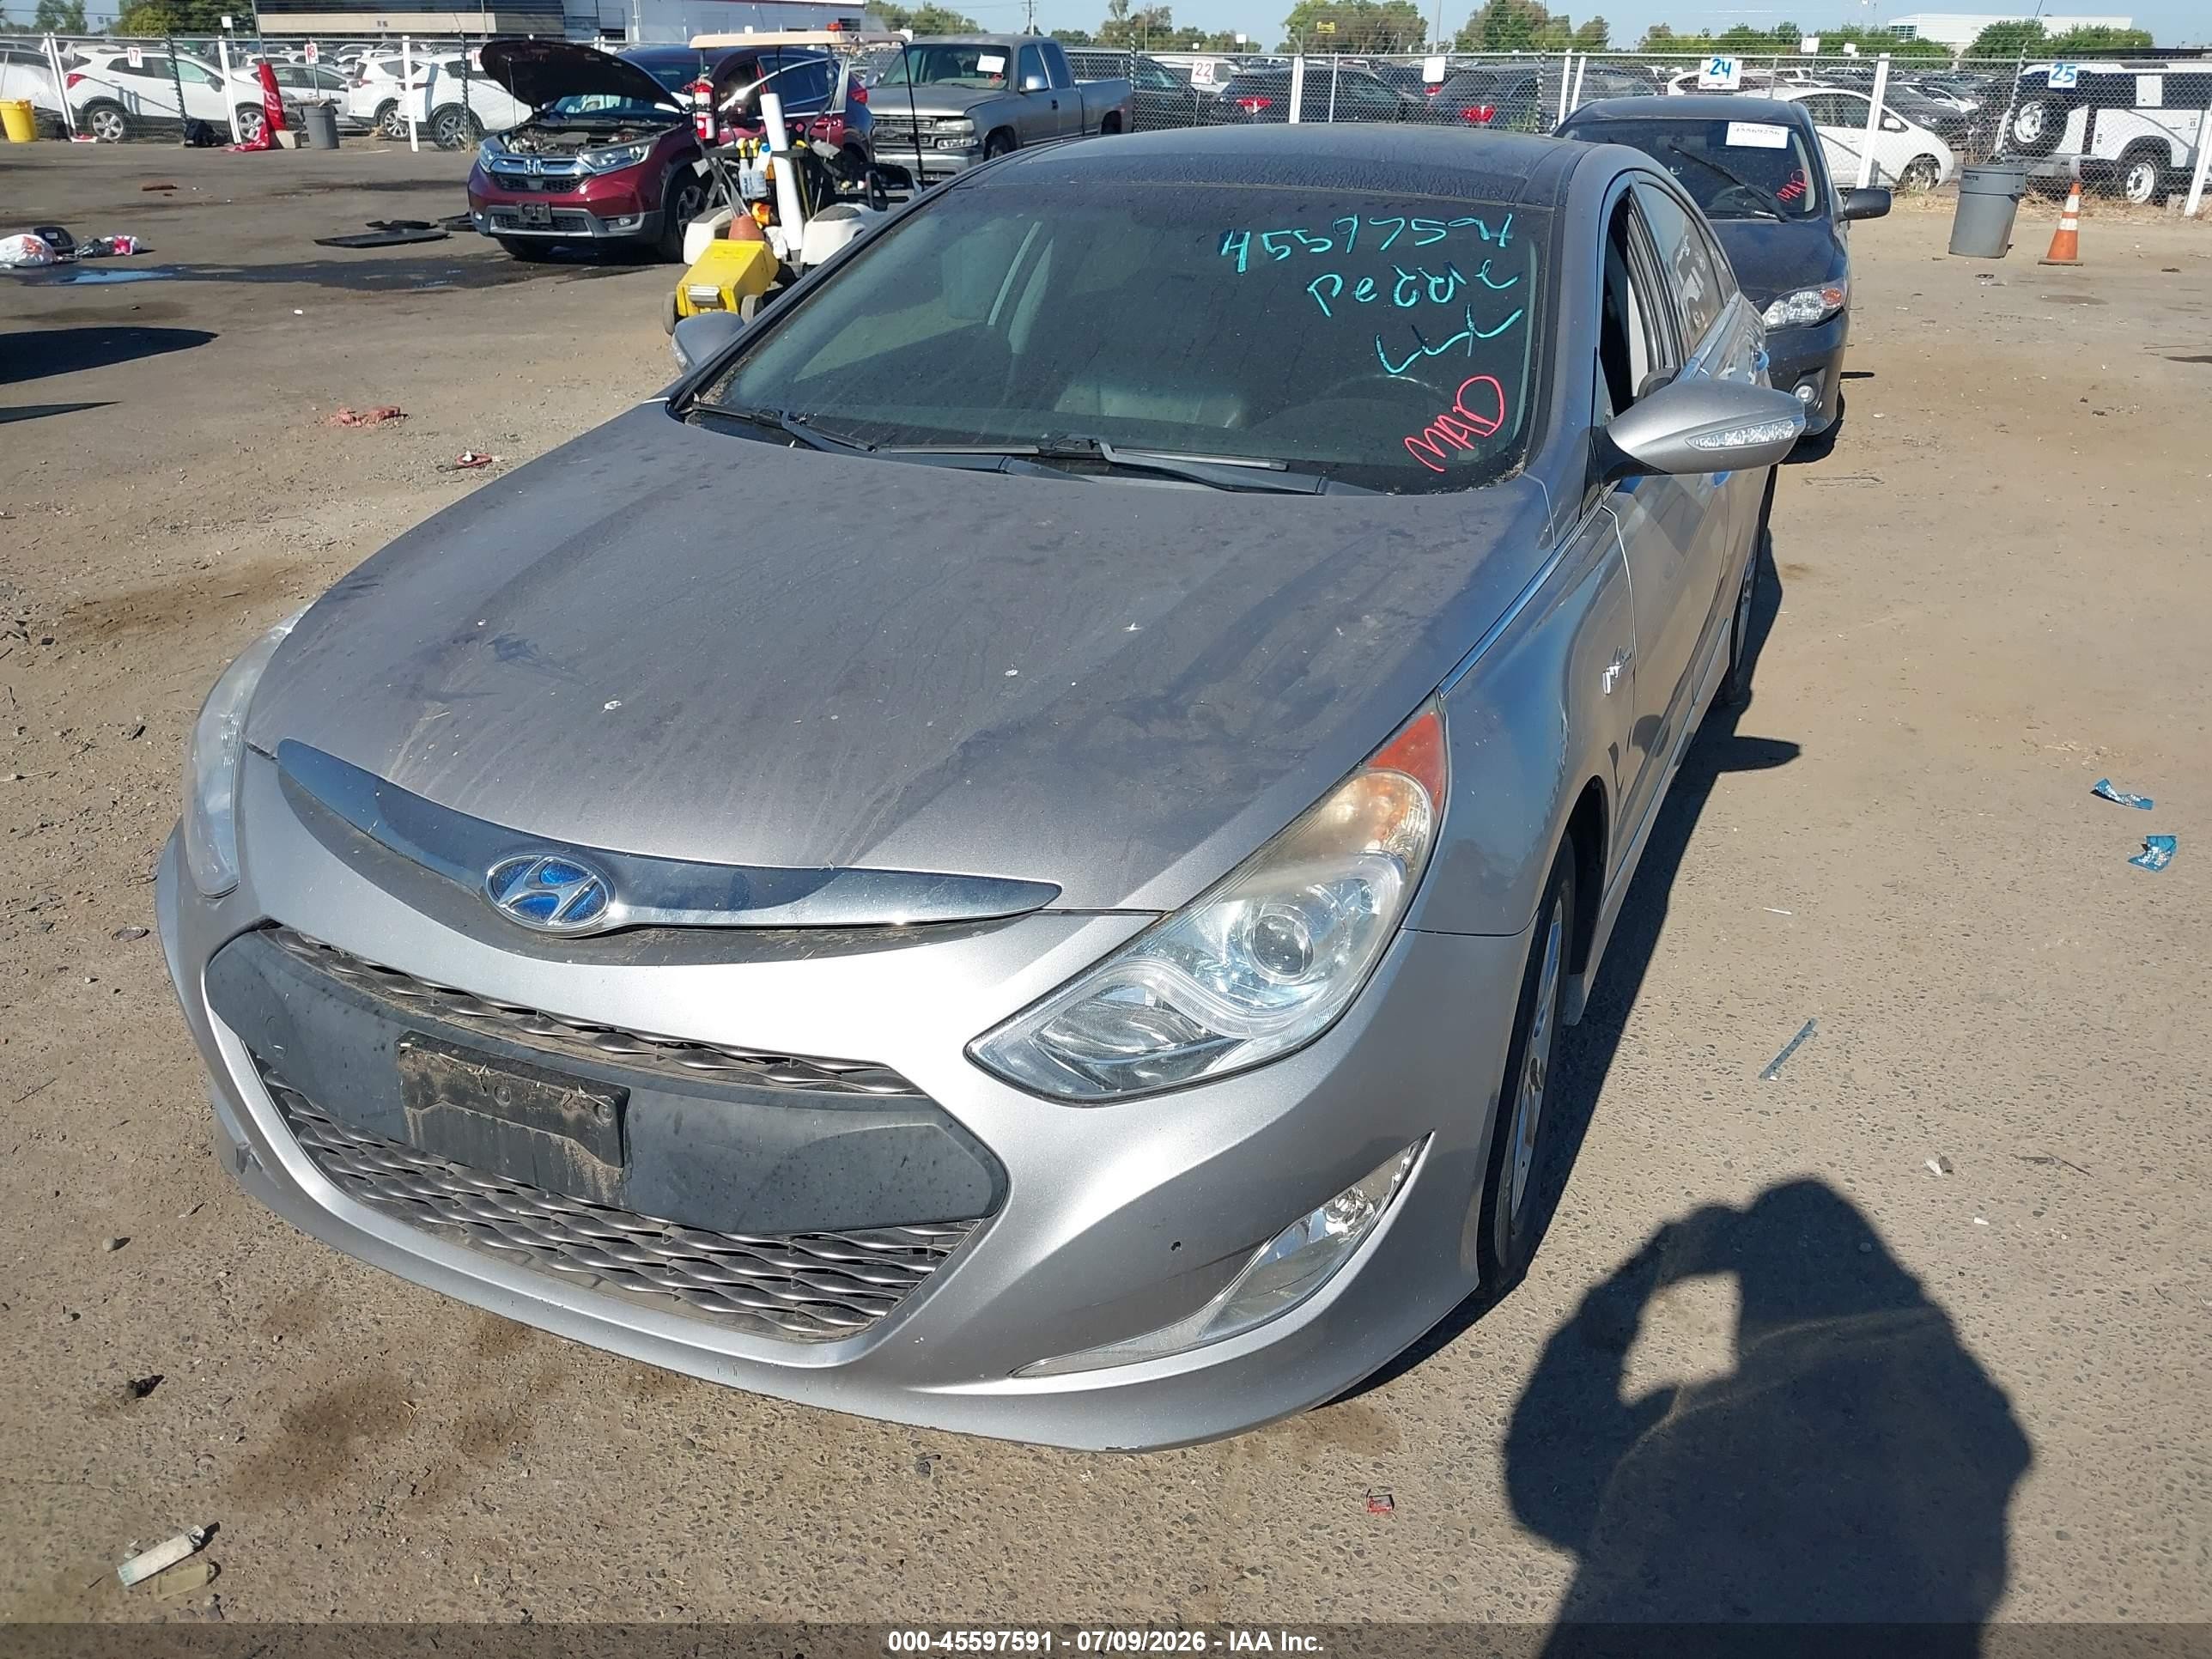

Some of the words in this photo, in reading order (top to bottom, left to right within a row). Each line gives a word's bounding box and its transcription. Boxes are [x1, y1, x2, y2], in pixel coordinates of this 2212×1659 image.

[129, 48, 140, 63] 17
[1195, 62, 1212, 77] 22
[1709, 58, 1732, 80] 24
[2051, 63, 2077, 83] 25
[1403, 374, 1505, 473] MAD
